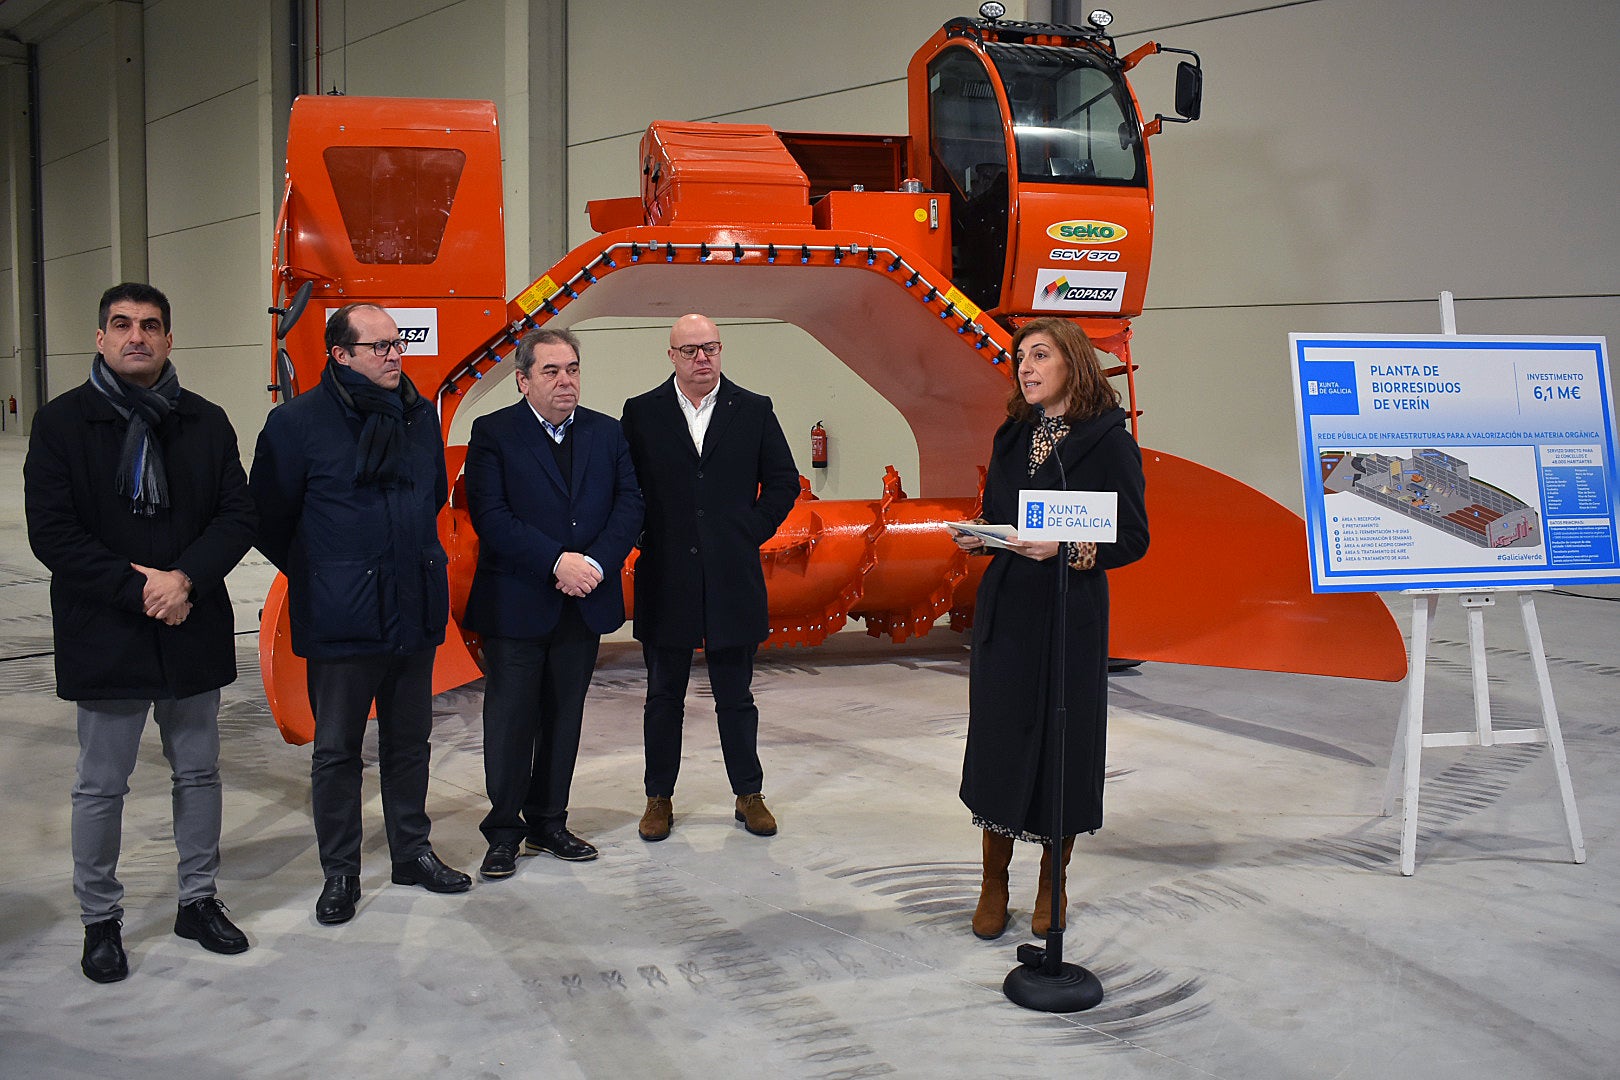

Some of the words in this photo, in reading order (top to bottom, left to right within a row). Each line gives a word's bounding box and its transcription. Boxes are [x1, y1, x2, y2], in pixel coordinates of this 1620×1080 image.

[1060, 224, 1114, 238] seko
[1067, 289, 1114, 299] COPASA
[399, 330, 426, 340] ASA
[1370, 366, 1420, 376] PLANTA
[1424, 366, 1439, 376] DE
[1372, 382, 1461, 393] BIORRESIDUOS
[1534, 386, 1553, 401] 6,1
[1558, 386, 1581, 399] M€
[1374, 399, 1390, 410] DE
[1393, 396, 1429, 410] VERÍN
[1338, 431, 1367, 440] PÚBLICA
[1472, 430, 1521, 438] VALORIZACIÓN
[1565, 430, 1599, 438] ORGÁNICA
[1049, 505, 1087, 514] XUNTA
[1048, 517, 1062, 526] DE
[1066, 518, 1111, 528] GALICIA
